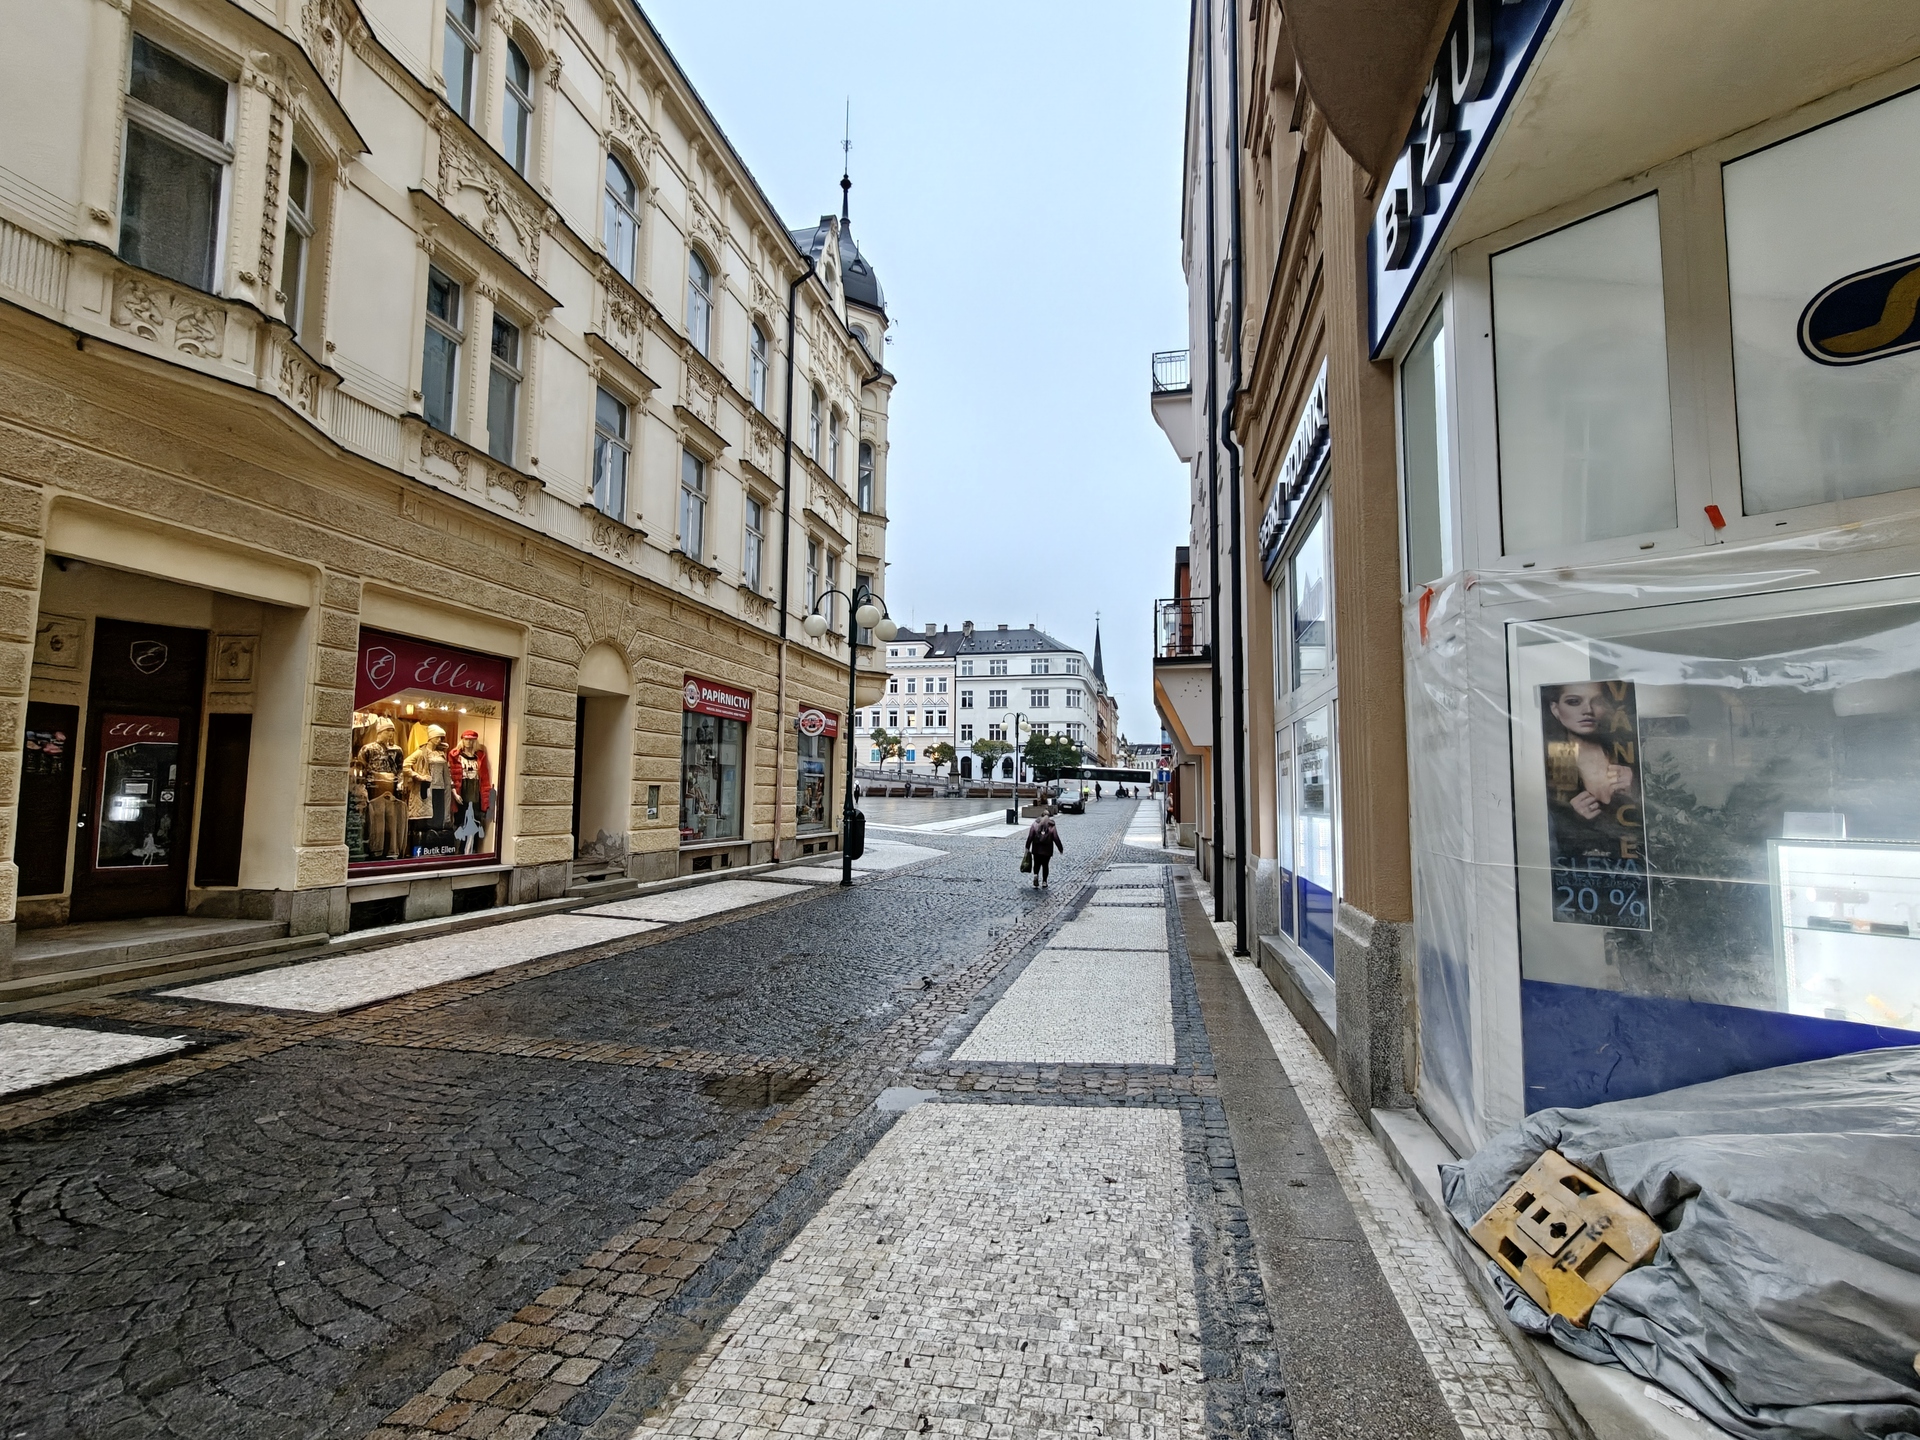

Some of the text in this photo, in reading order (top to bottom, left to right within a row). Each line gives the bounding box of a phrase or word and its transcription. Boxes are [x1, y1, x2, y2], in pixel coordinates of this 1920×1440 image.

[1384, 0, 1522, 271] BIŽU
[1285, 377, 1329, 500] HODINKY
[414, 656, 494, 692] Ellen
[702, 687, 750, 710] PAPÍRNICTVÍ
[1606, 680, 1640, 859] VÁNCE
[423, 846, 440, 856] Butik
[440, 845, 456, 855] Ellen
[1555, 856, 1642, 880] SLEVA
[1556, 886, 1646, 917] 20 %
